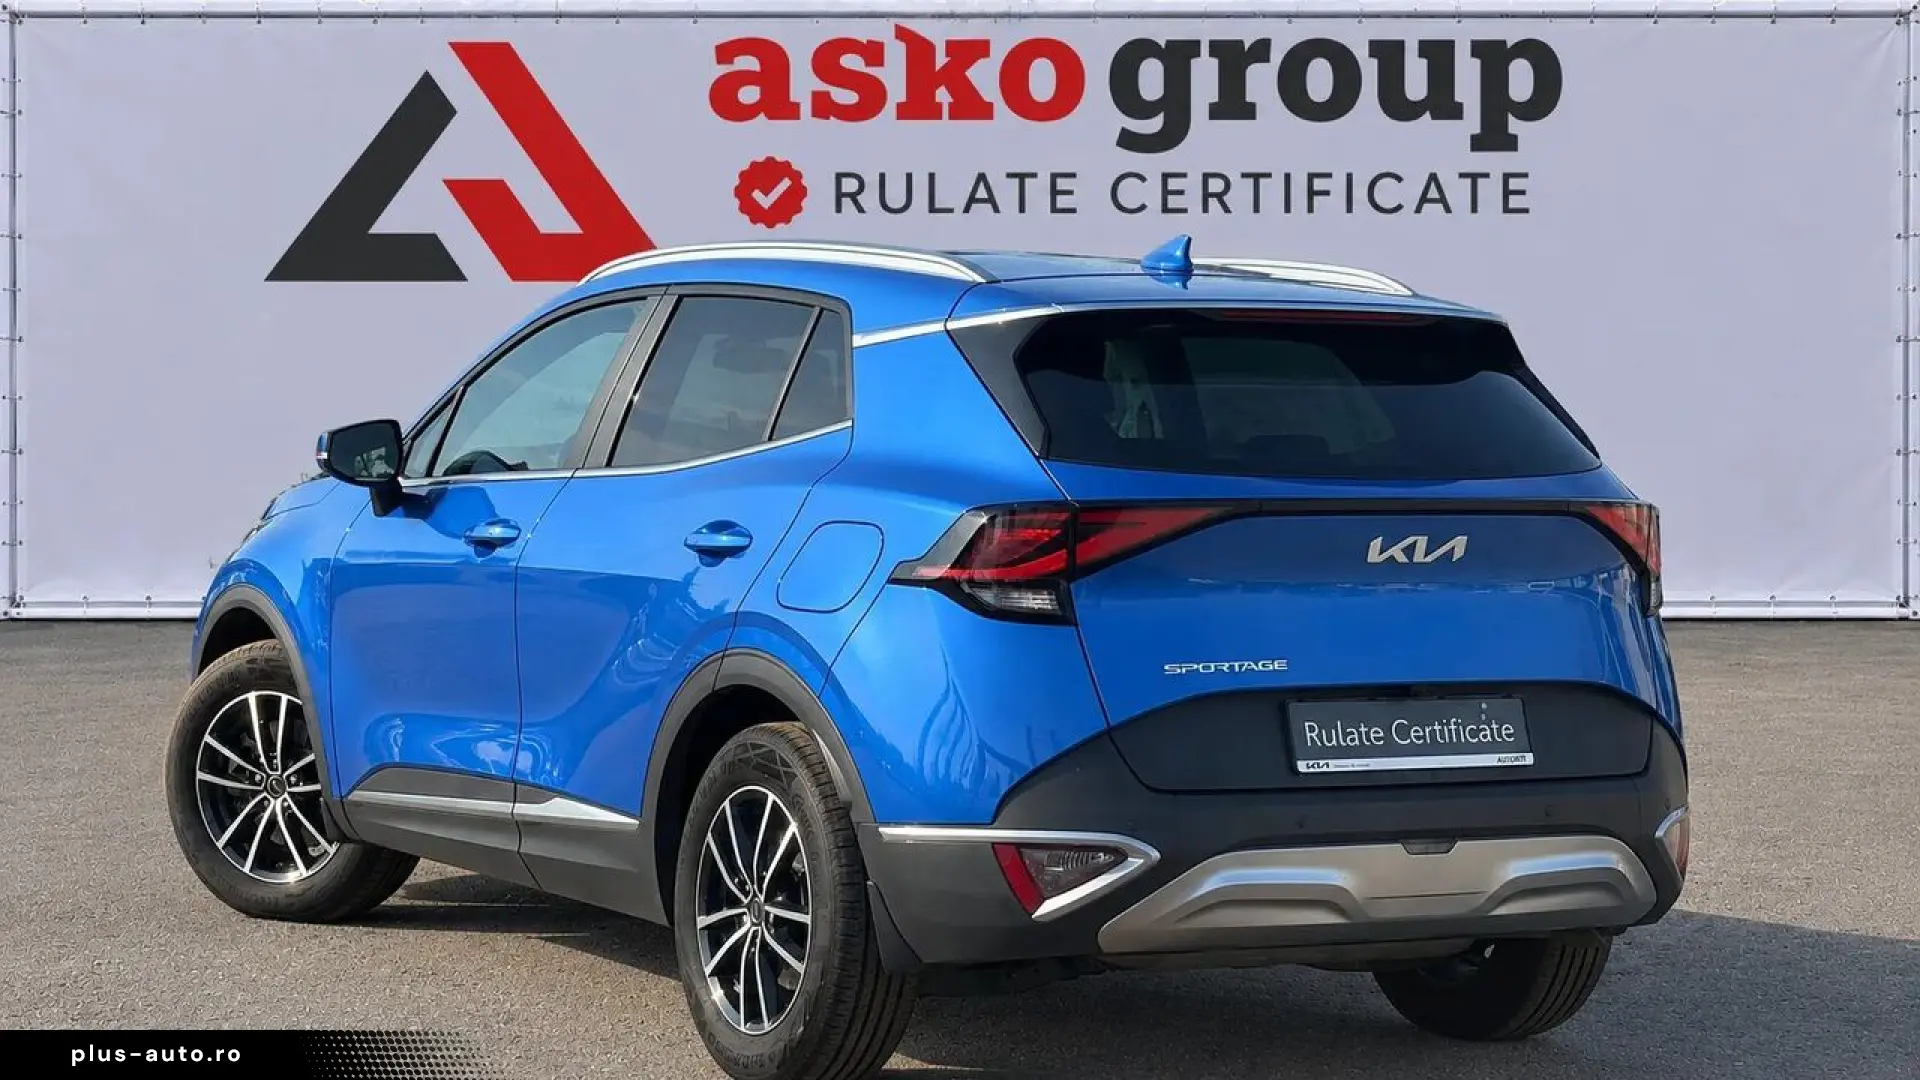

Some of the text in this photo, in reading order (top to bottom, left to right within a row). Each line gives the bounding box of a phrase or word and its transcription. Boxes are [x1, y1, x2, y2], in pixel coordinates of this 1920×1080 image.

[709, 25, 1563, 154] asko group
[834, 171, 1530, 215] RULATE CERTIFICATE
[1367, 535, 1468, 563] KIA
[1164, 659, 1288, 675] SPORTAGE
[1304, 717, 1515, 747] Rulate Certificate
